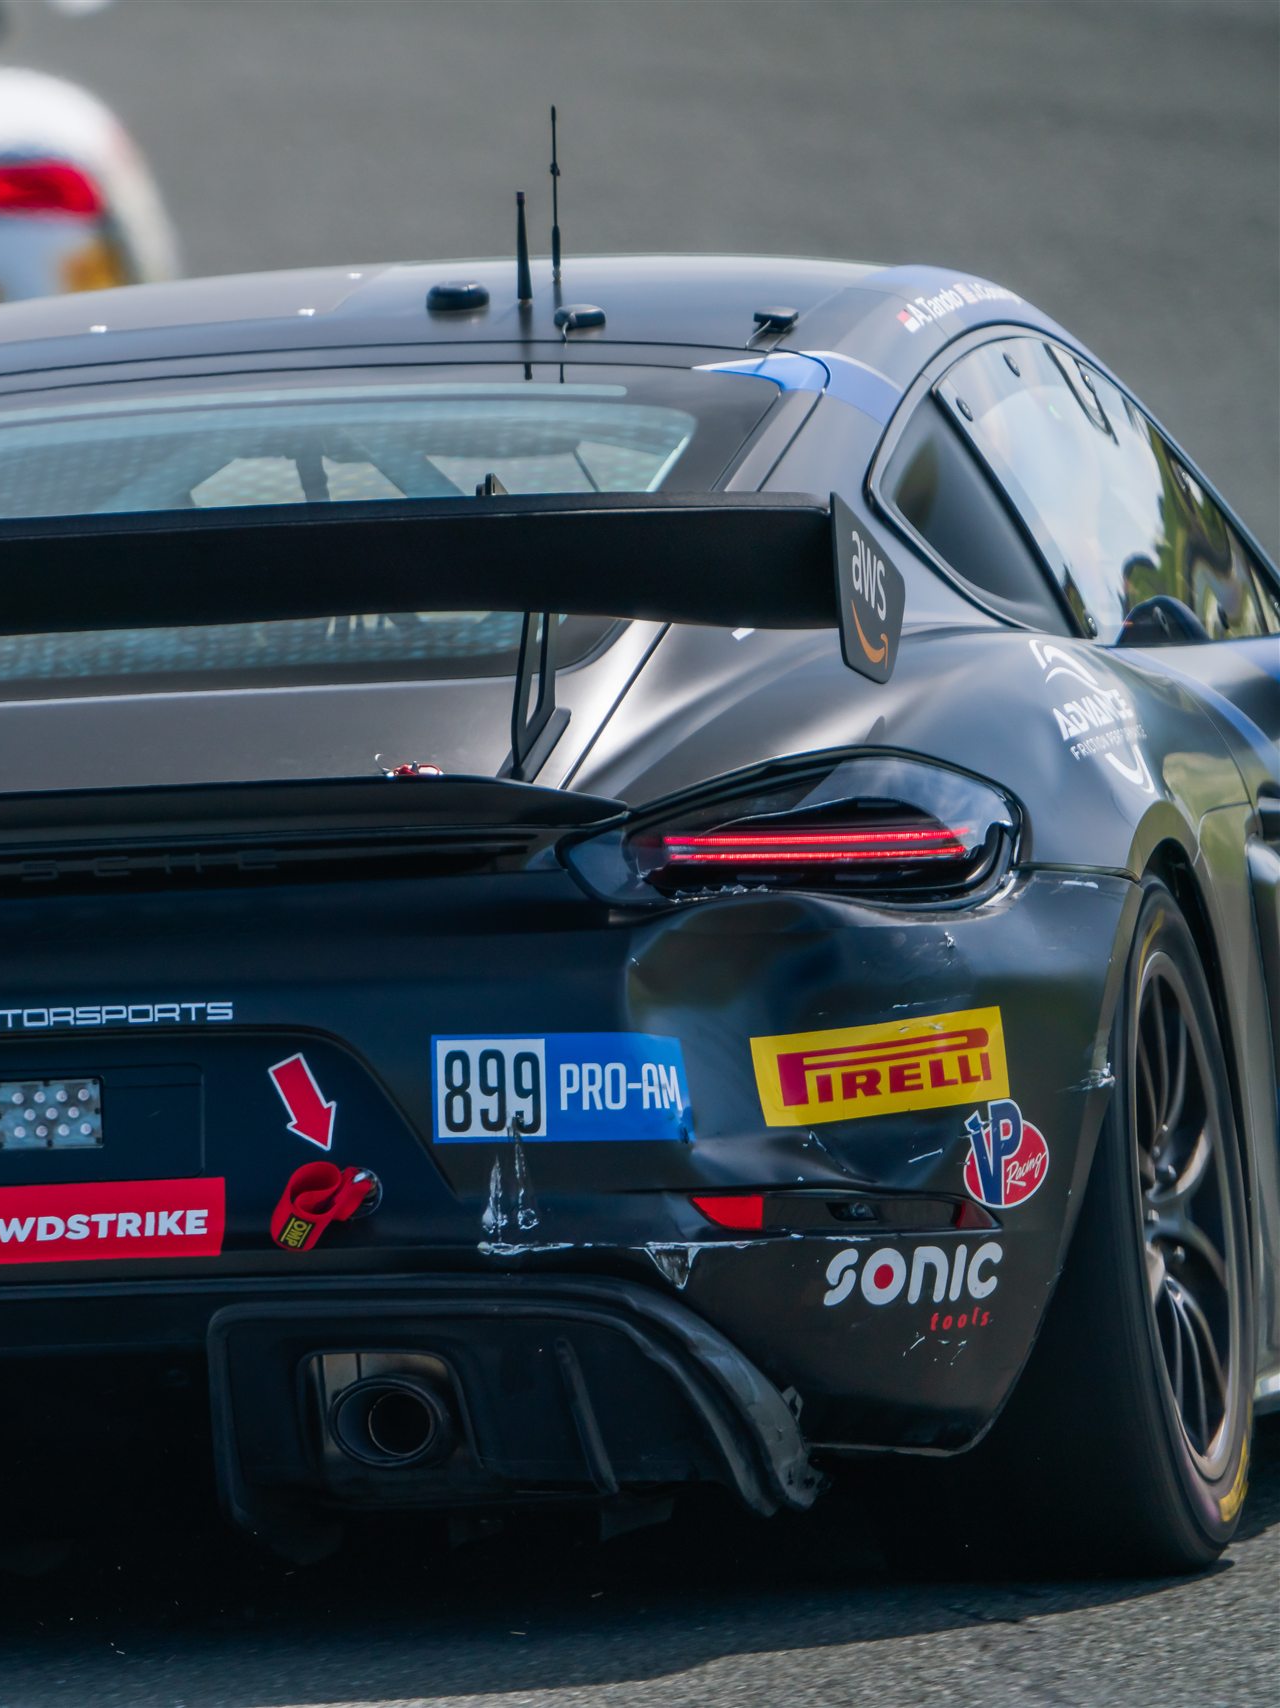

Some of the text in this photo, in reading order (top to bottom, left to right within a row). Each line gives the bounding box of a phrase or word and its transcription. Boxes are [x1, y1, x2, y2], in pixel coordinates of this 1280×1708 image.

[851, 530, 887, 622] aws
[443, 1048, 684, 1135] 899 PRO-AM
[776, 1027, 993, 1107] PIRELLI
[963, 1098, 1024, 1206] VP
[1006, 1151, 1047, 1195] Racing
[285, 1220, 308, 1247] OMP
[823, 1241, 1004, 1307] SONIC
[930, 1306, 992, 1332] tools
